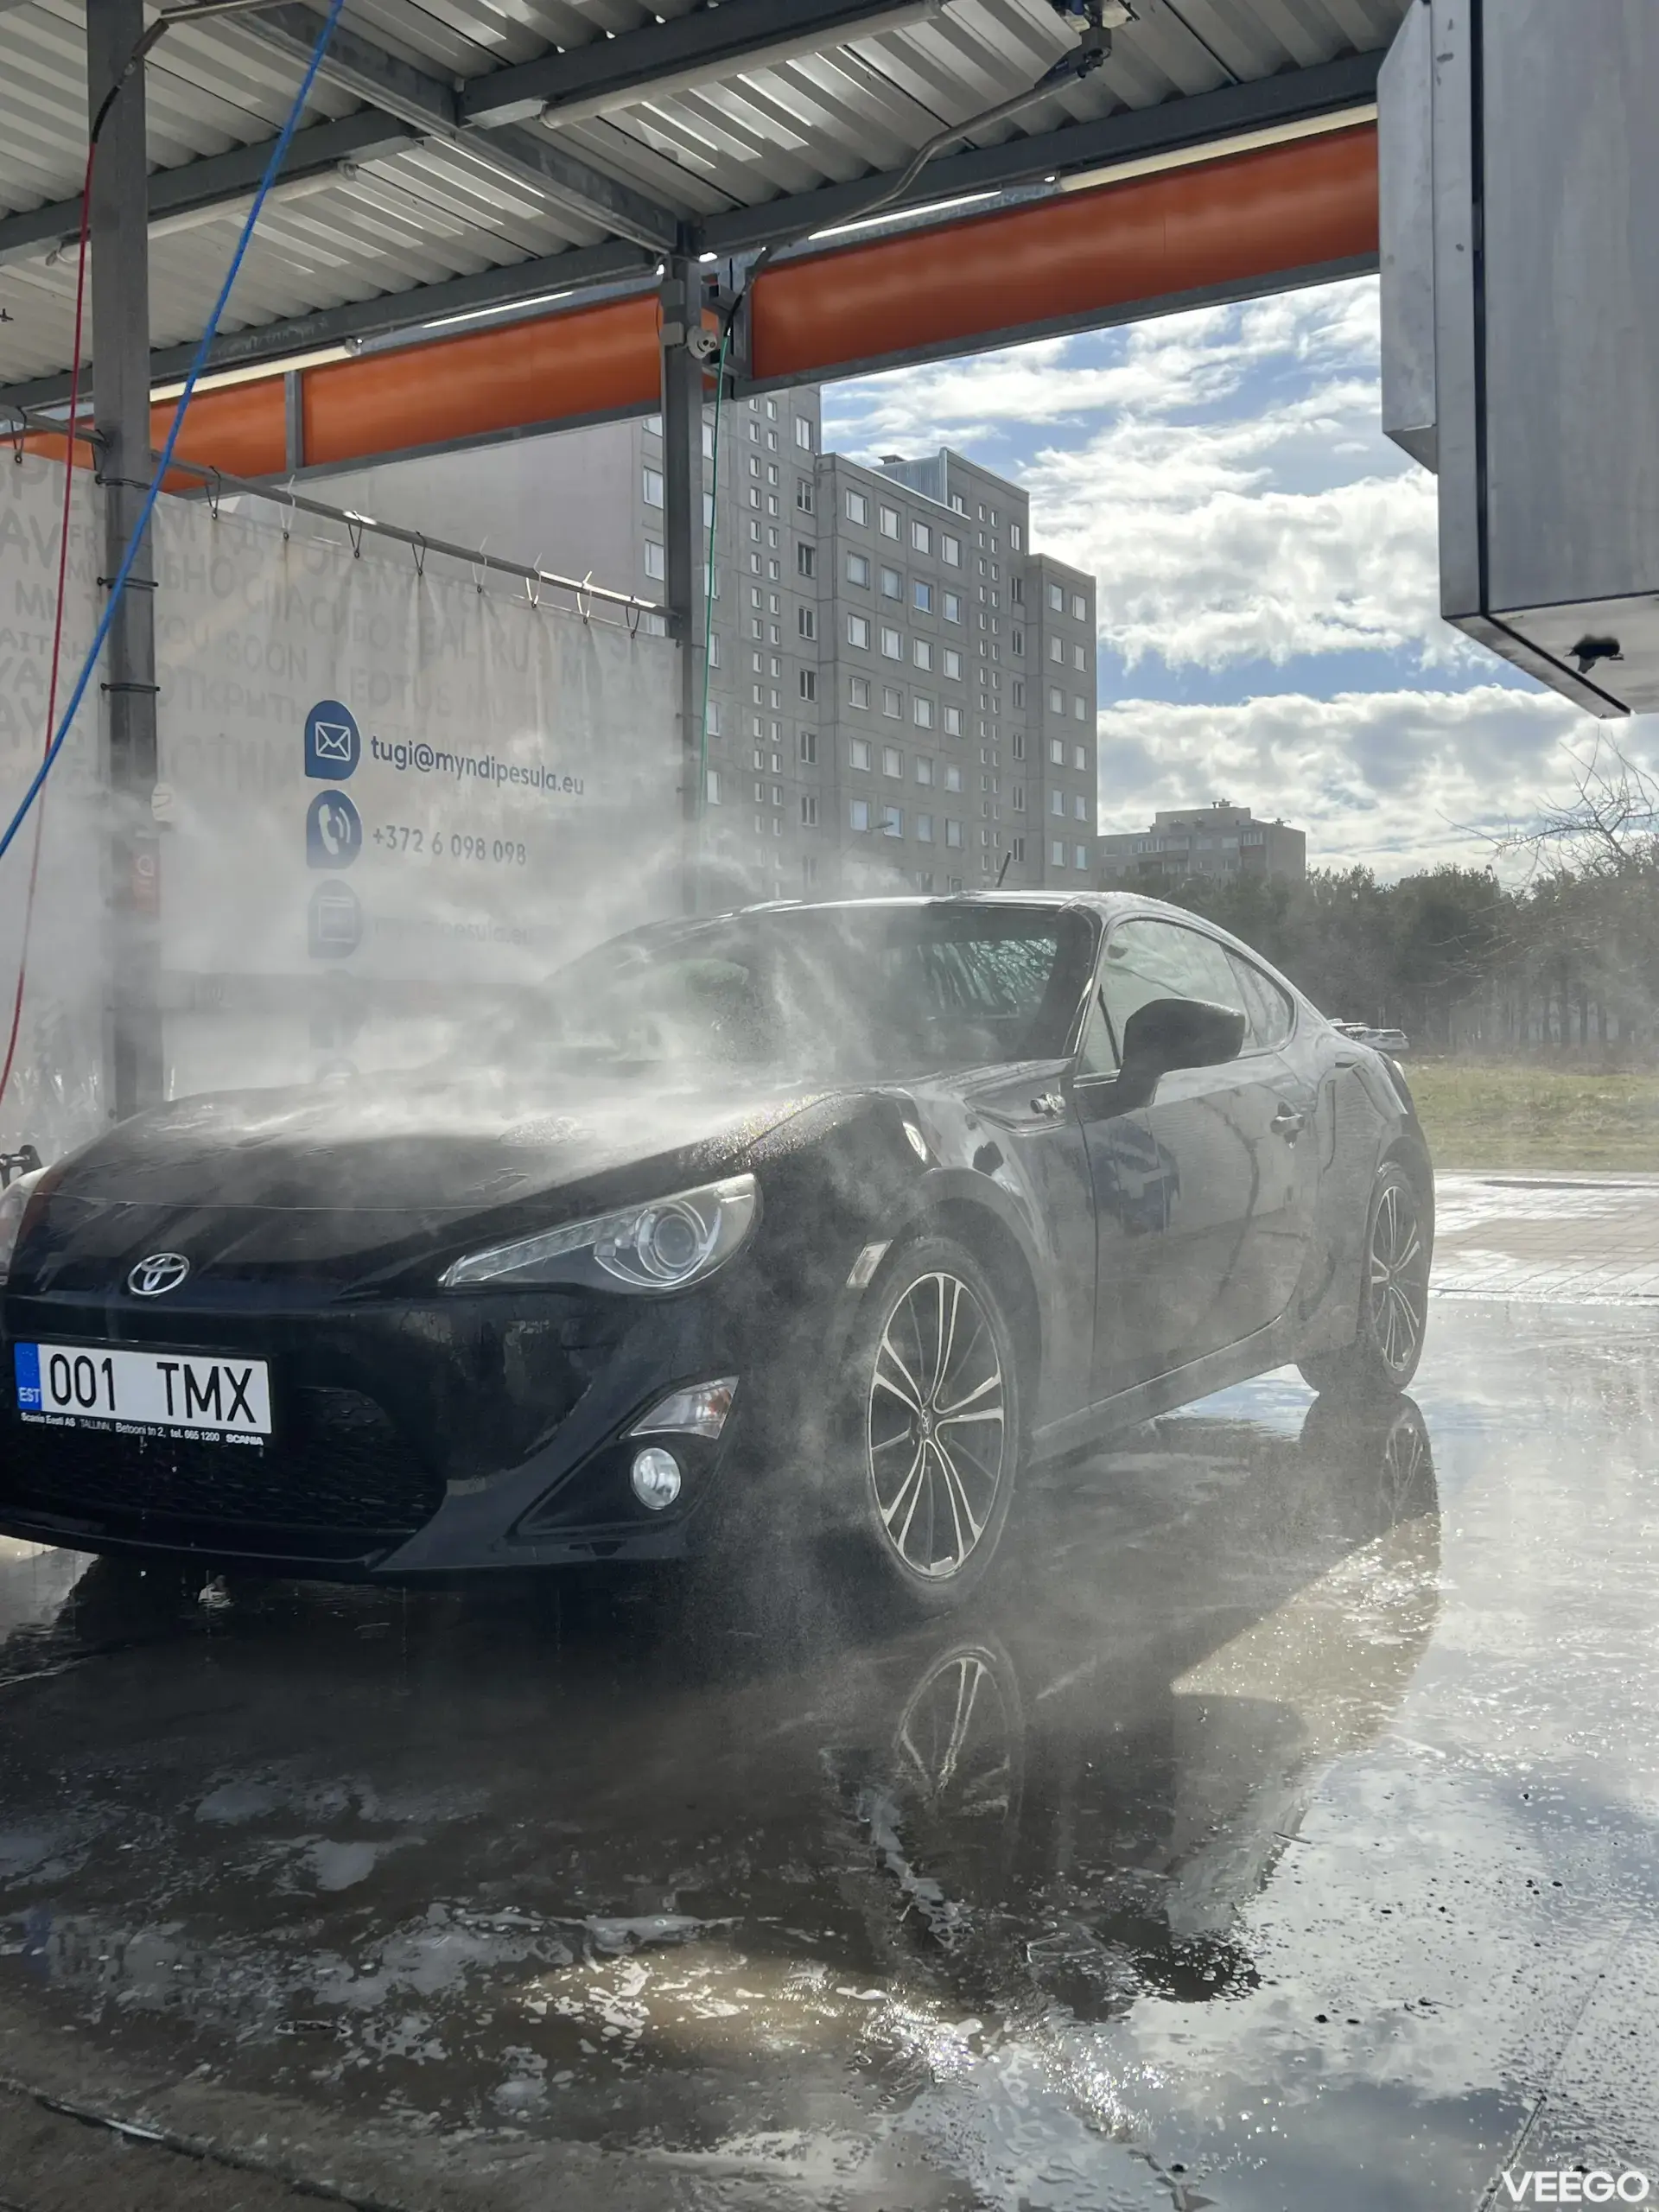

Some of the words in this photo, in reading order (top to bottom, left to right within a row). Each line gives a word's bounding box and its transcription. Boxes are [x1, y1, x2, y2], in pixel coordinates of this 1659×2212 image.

[371, 735, 585, 797] tugi@myndipesula.eu
[372, 824, 424, 854] +372
[432, 830, 444, 856] 6
[450, 834, 487, 861] 098
[493, 839, 527, 867] 098
[19, 1387, 41, 1402] EST
[50, 1353, 116, 1412] 001
[156, 1361, 257, 1424] TMX
